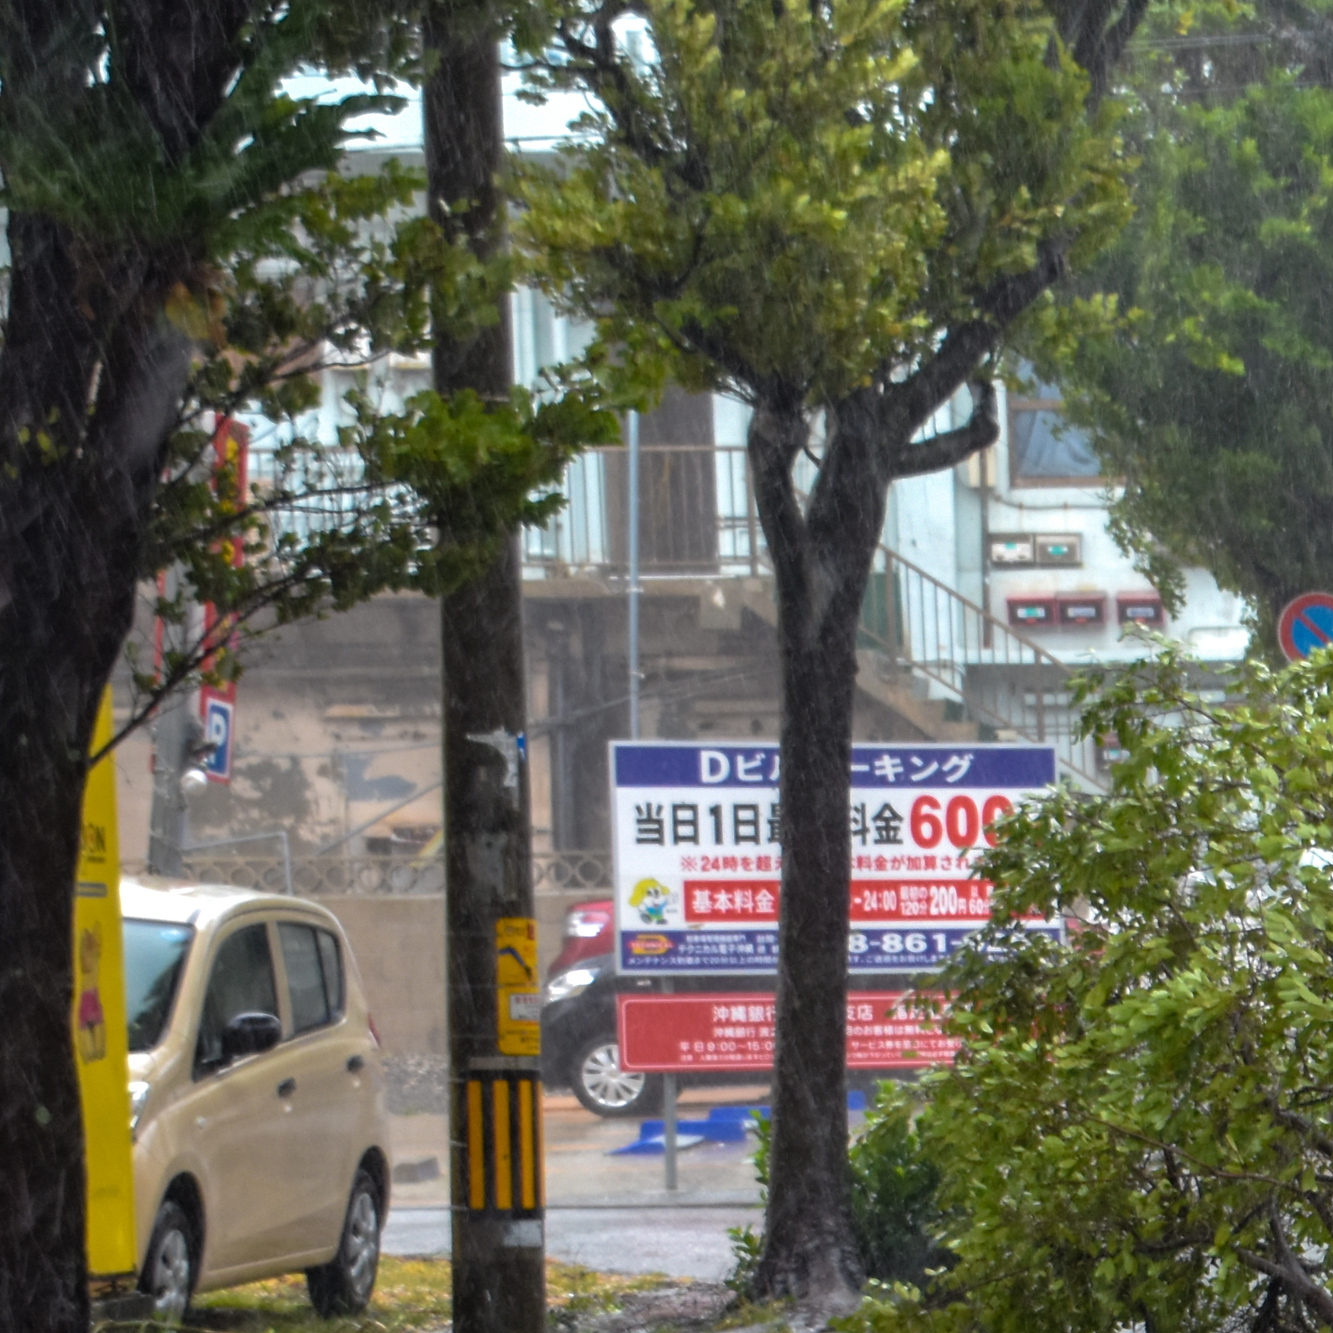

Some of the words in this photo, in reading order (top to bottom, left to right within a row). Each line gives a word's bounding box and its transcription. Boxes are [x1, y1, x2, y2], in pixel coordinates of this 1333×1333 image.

[692, 888, 775, 914] 基本料金
[850, 888, 897, 912] -24:00
